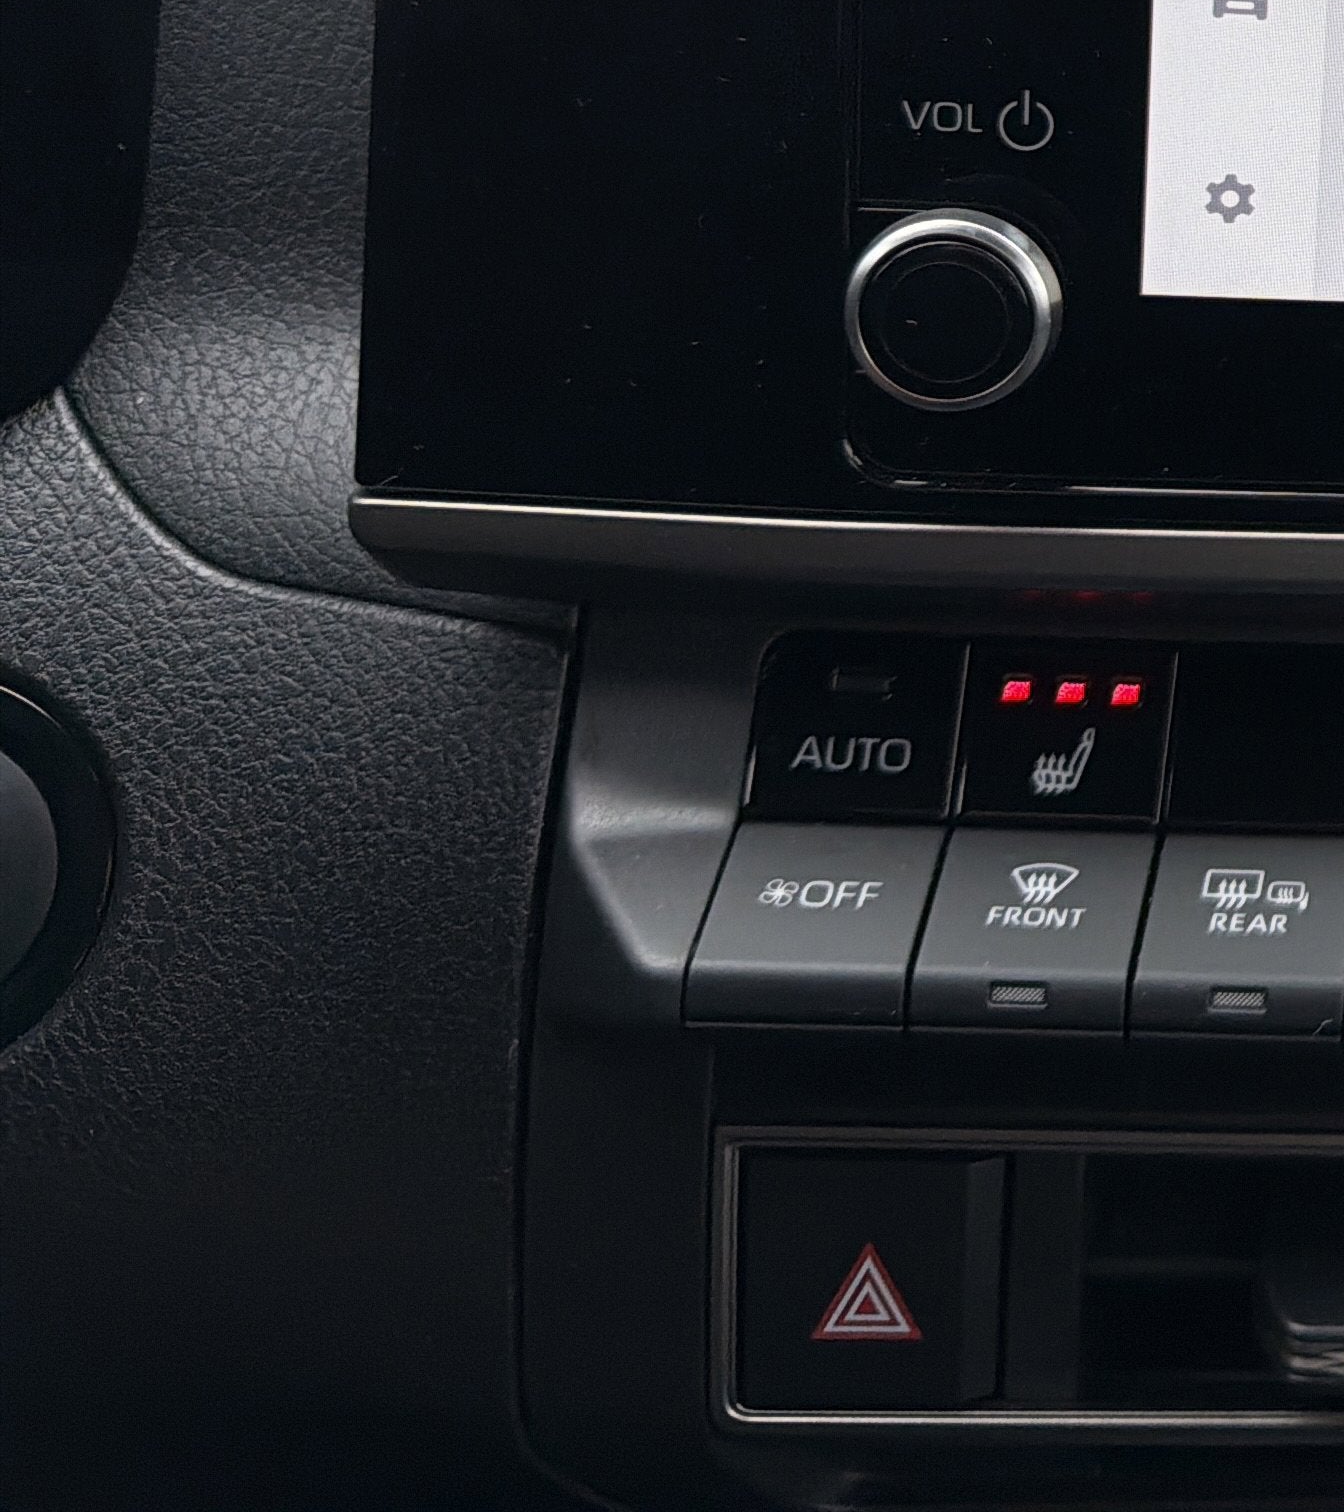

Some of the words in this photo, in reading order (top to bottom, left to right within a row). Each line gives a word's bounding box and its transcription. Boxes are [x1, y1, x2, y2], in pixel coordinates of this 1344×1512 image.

[902, 100, 983, 133] VOL
[791, 736, 912, 774] AUTO
[800, 879, 883, 910] OFF
[986, 904, 1087, 930] FRONT
[1207, 911, 1289, 937] REAR
